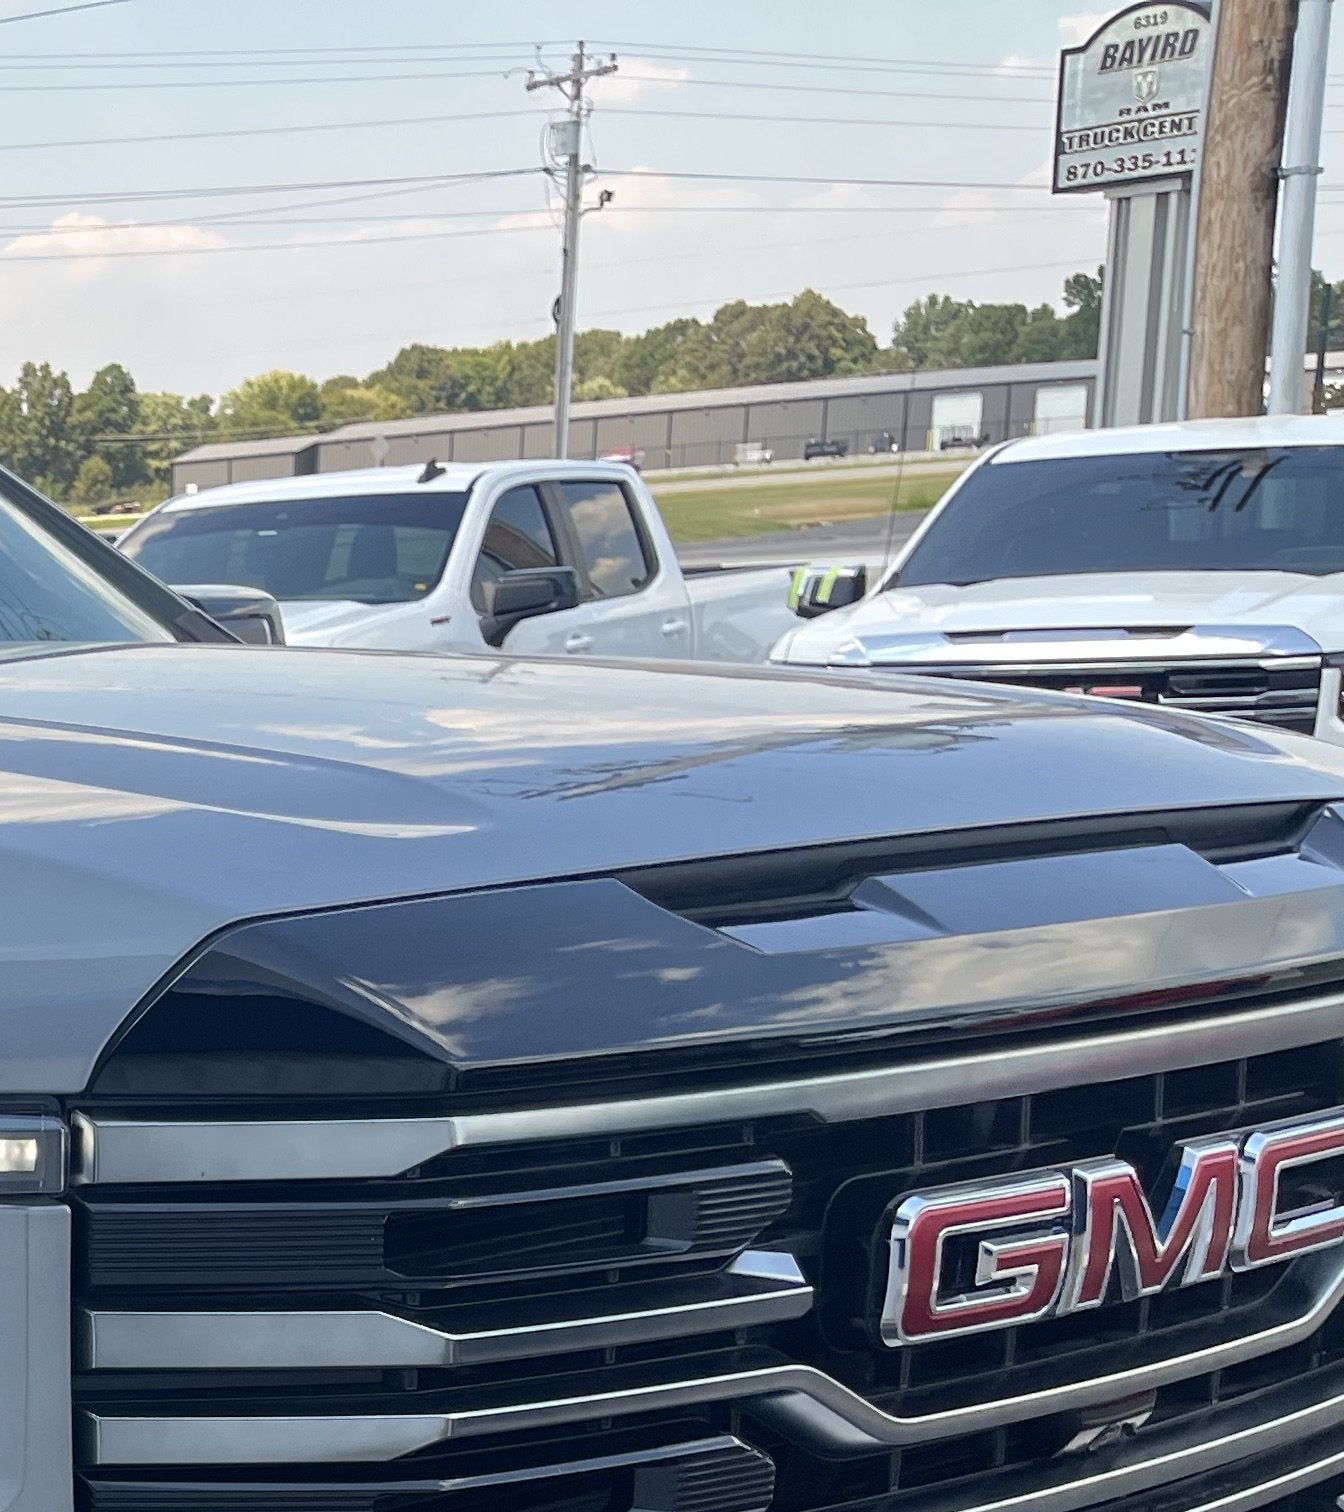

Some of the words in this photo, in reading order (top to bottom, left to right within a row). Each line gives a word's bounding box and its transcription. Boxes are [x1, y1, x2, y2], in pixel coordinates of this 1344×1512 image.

[1133, 11, 1169, 30] 6319
[1099, 28, 1200, 71] BAYIRD
[1118, 101, 1171, 117] RAM
[1065, 124, 1136, 150] TRUCK
[1065, 147, 1197, 183] 870-335-11
[880, 1112, 1344, 1348] GMC
